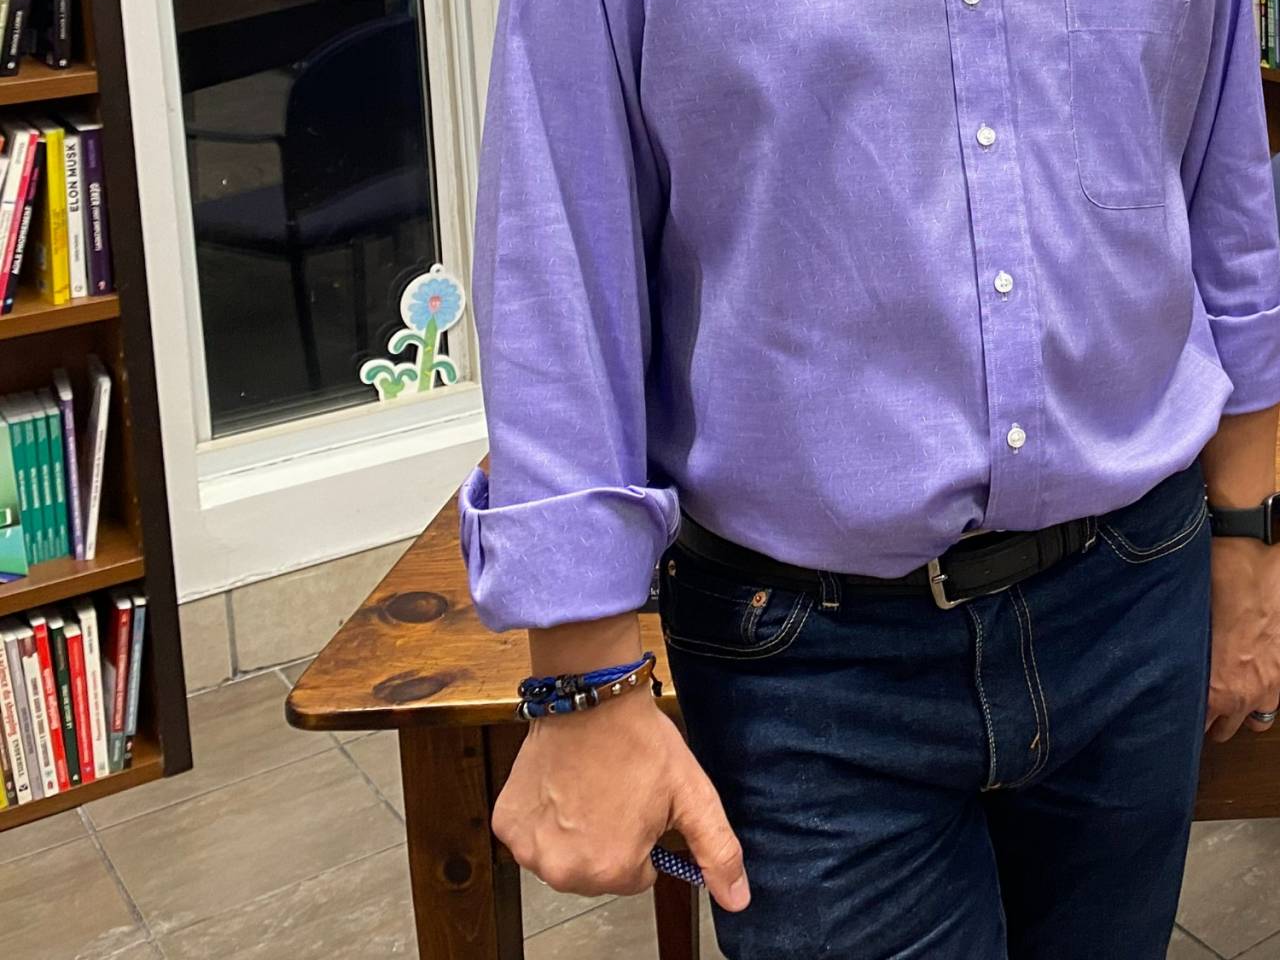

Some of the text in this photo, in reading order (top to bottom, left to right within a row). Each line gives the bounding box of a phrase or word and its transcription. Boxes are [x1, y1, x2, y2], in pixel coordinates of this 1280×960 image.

[65, 143, 80, 213] ELON MUSK
[11, 253, 23, 274] AGILE
[3, 701, 18, 738] shopping
